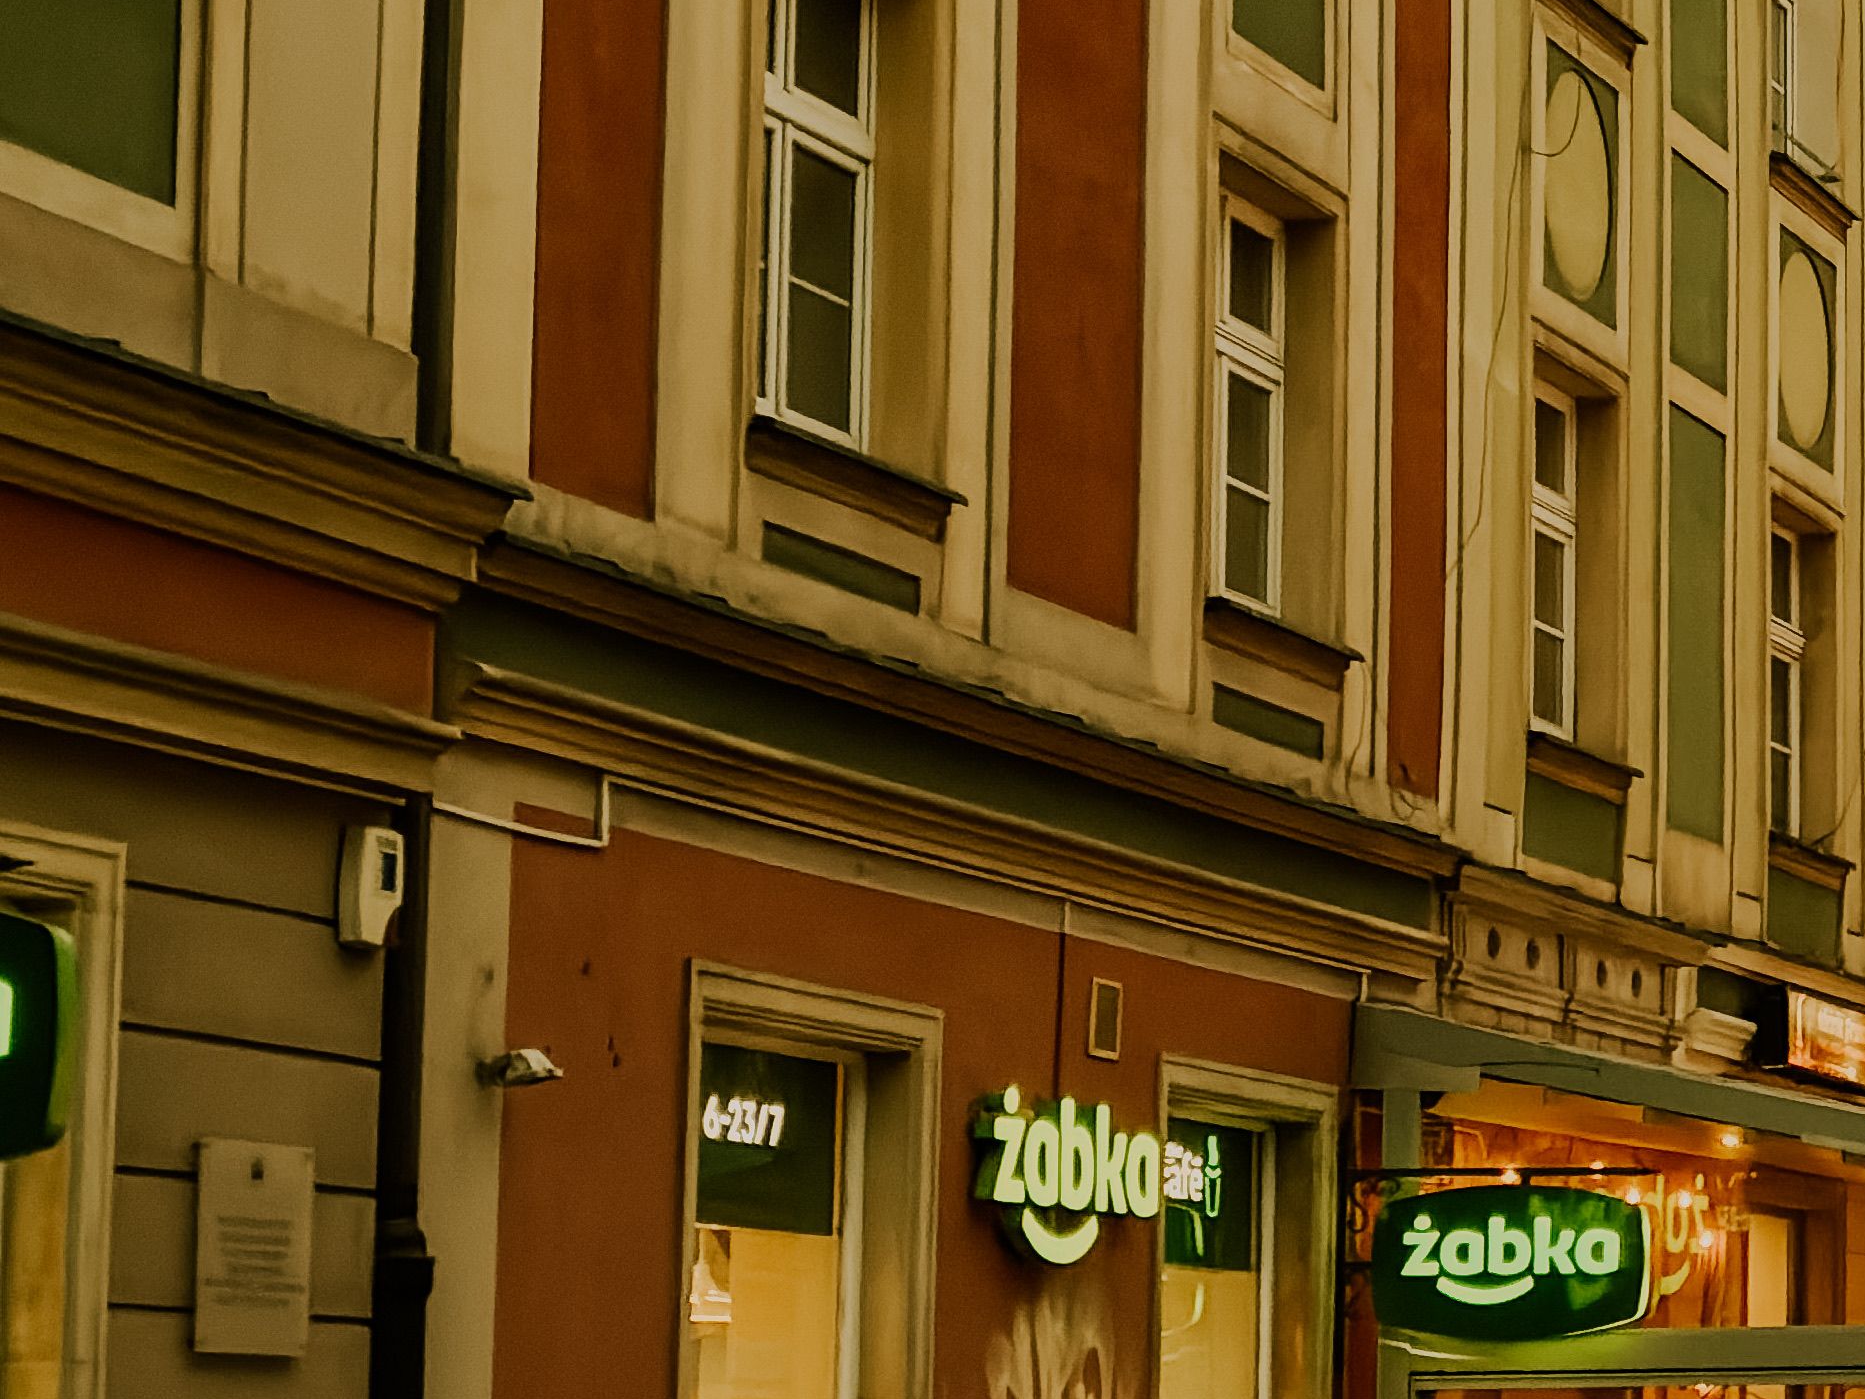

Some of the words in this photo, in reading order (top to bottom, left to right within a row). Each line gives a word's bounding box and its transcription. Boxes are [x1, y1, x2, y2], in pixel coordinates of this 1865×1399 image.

[703, 1094, 784, 1147] 6-23/7
[993, 1083, 1160, 1218] żabka
[1401, 1214, 1620, 1276] żabka
